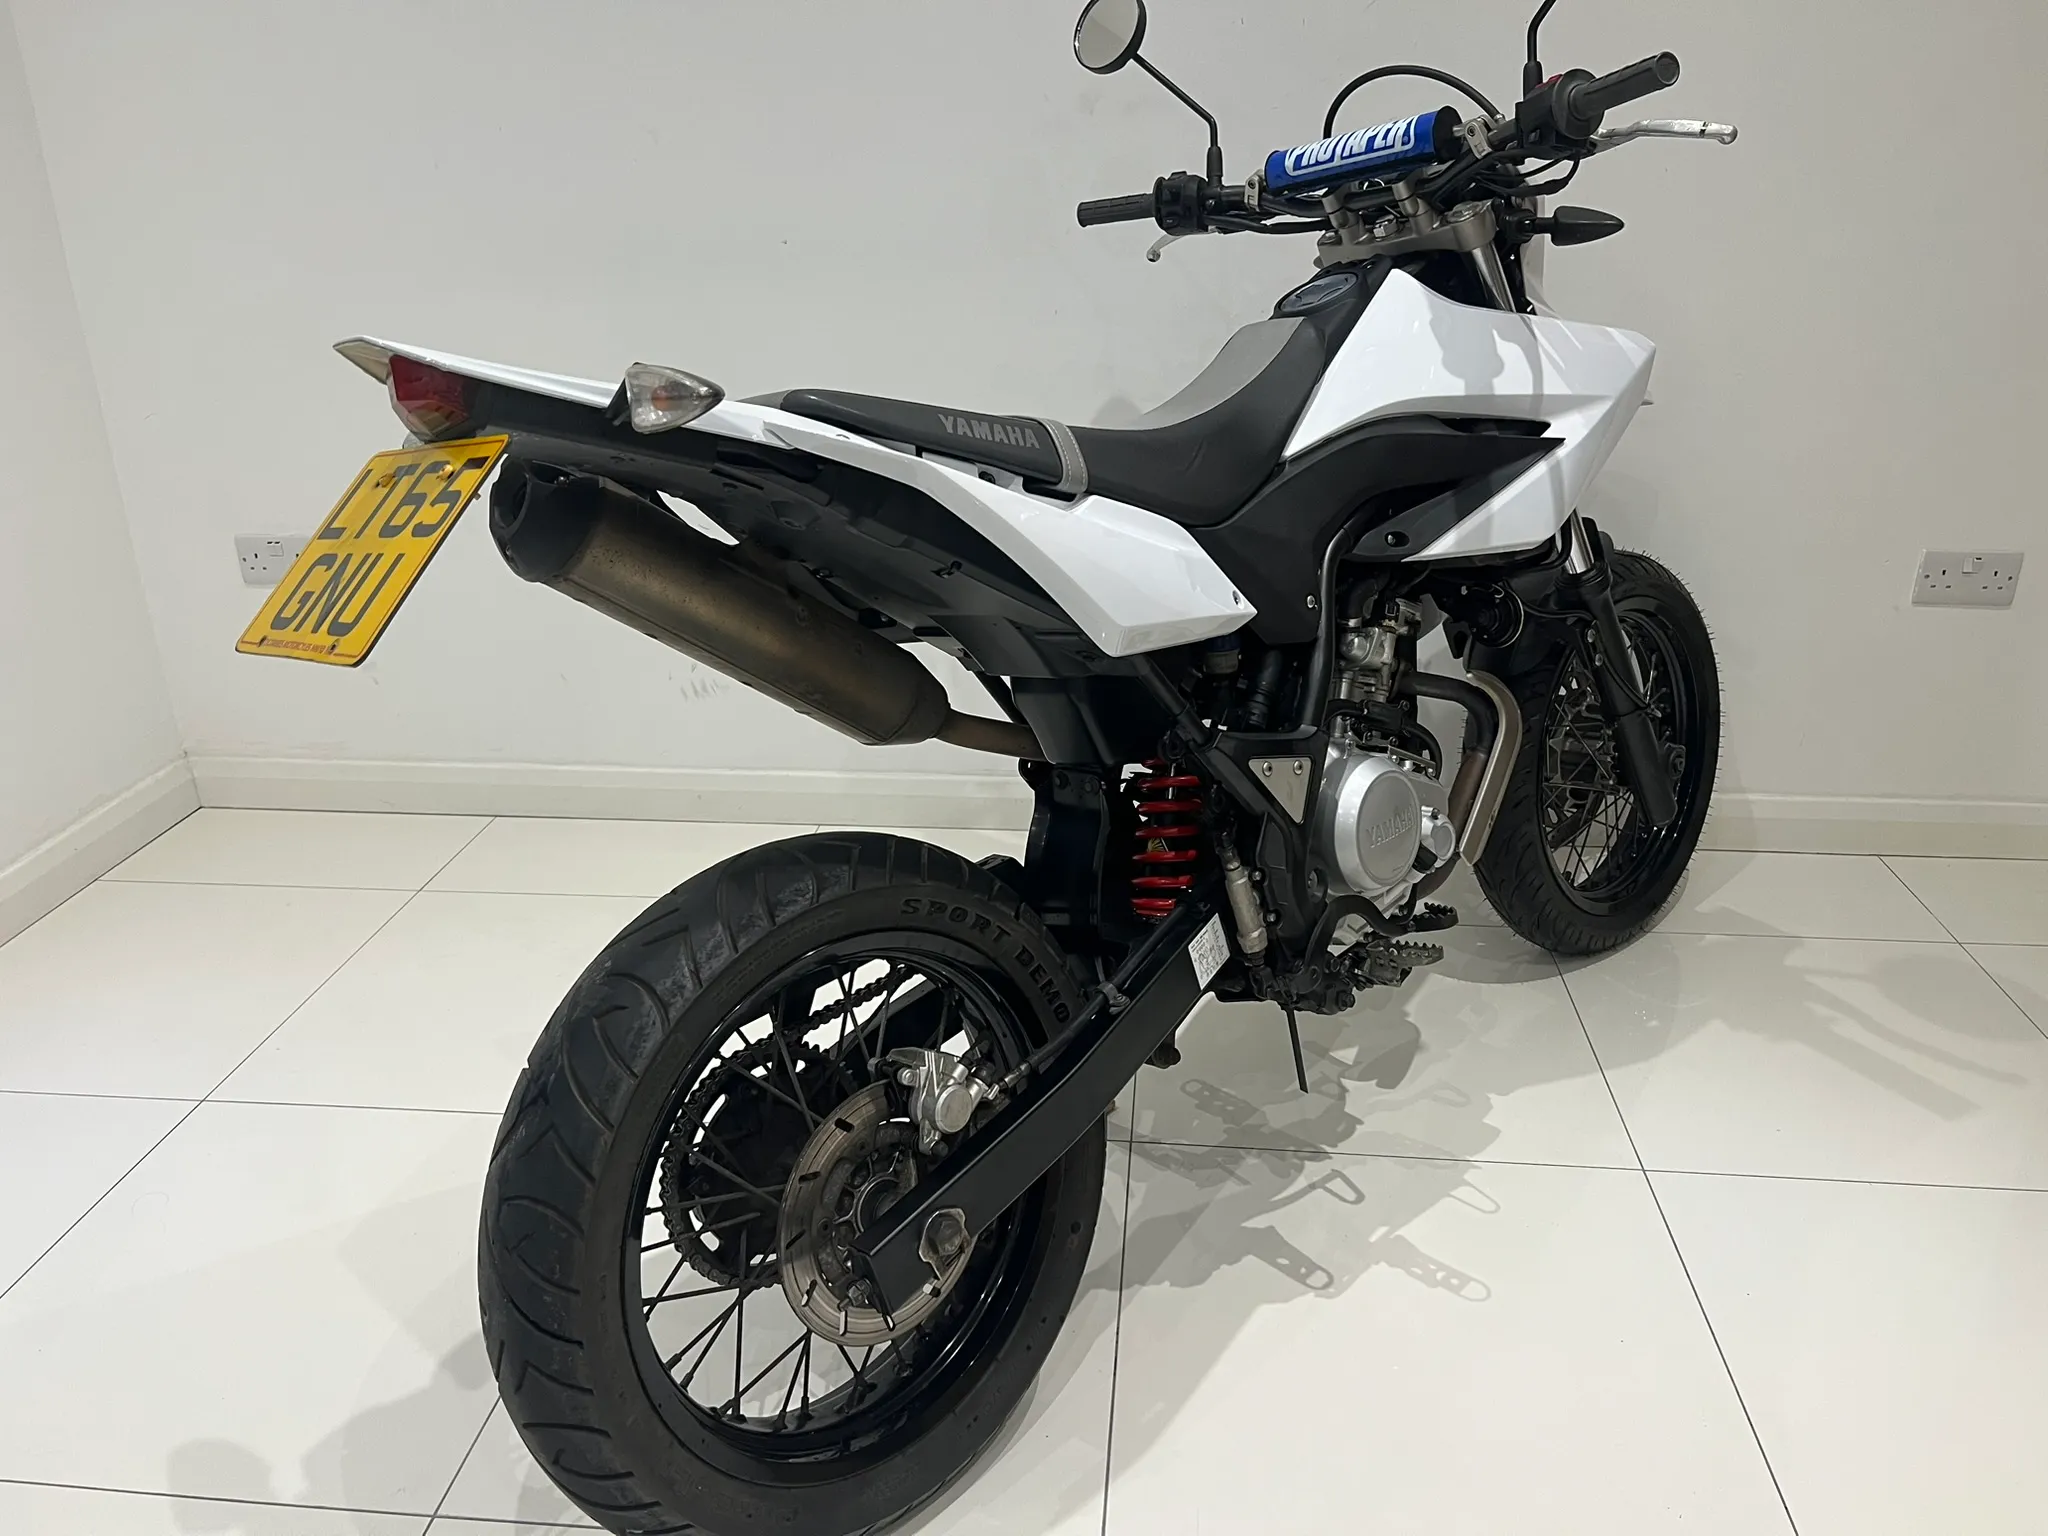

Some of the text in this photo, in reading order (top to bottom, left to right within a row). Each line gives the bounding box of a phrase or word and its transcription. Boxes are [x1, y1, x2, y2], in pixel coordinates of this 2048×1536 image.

[938, 413, 1040, 449] YAMAHA
[316, 456, 490, 540] LT65
[270, 553, 405, 637] GNU
[1366, 804, 1415, 848] YAMAHA
[901, 899, 1012, 943] SPORT
